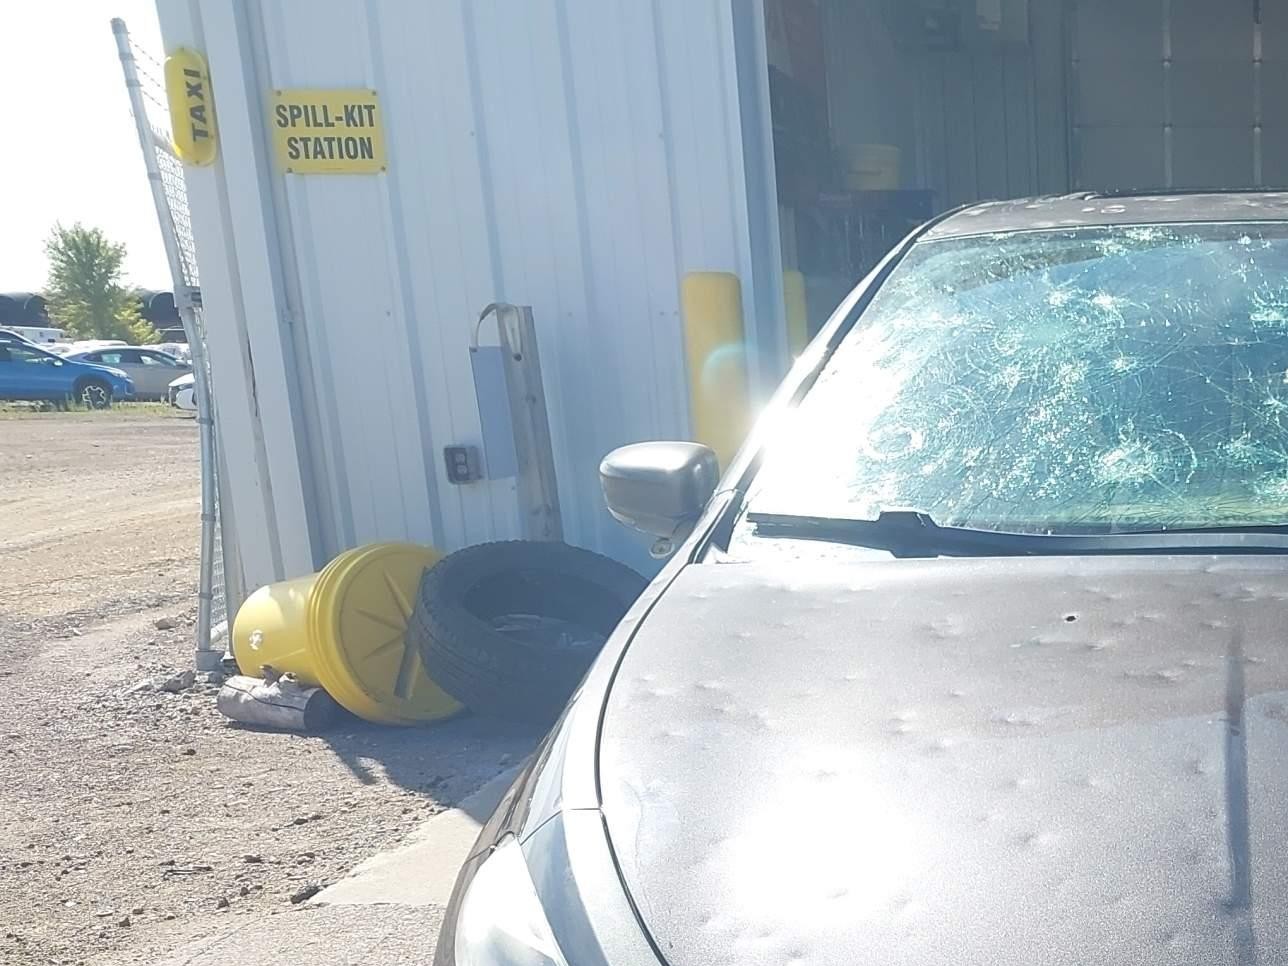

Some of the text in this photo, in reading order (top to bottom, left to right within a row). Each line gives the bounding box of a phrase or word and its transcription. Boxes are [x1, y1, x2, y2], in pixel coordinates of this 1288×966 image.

[184, 69, 210, 143] TAXI
[276, 104, 376, 128] SPILL-KIT
[287, 136, 374, 160] STATION
